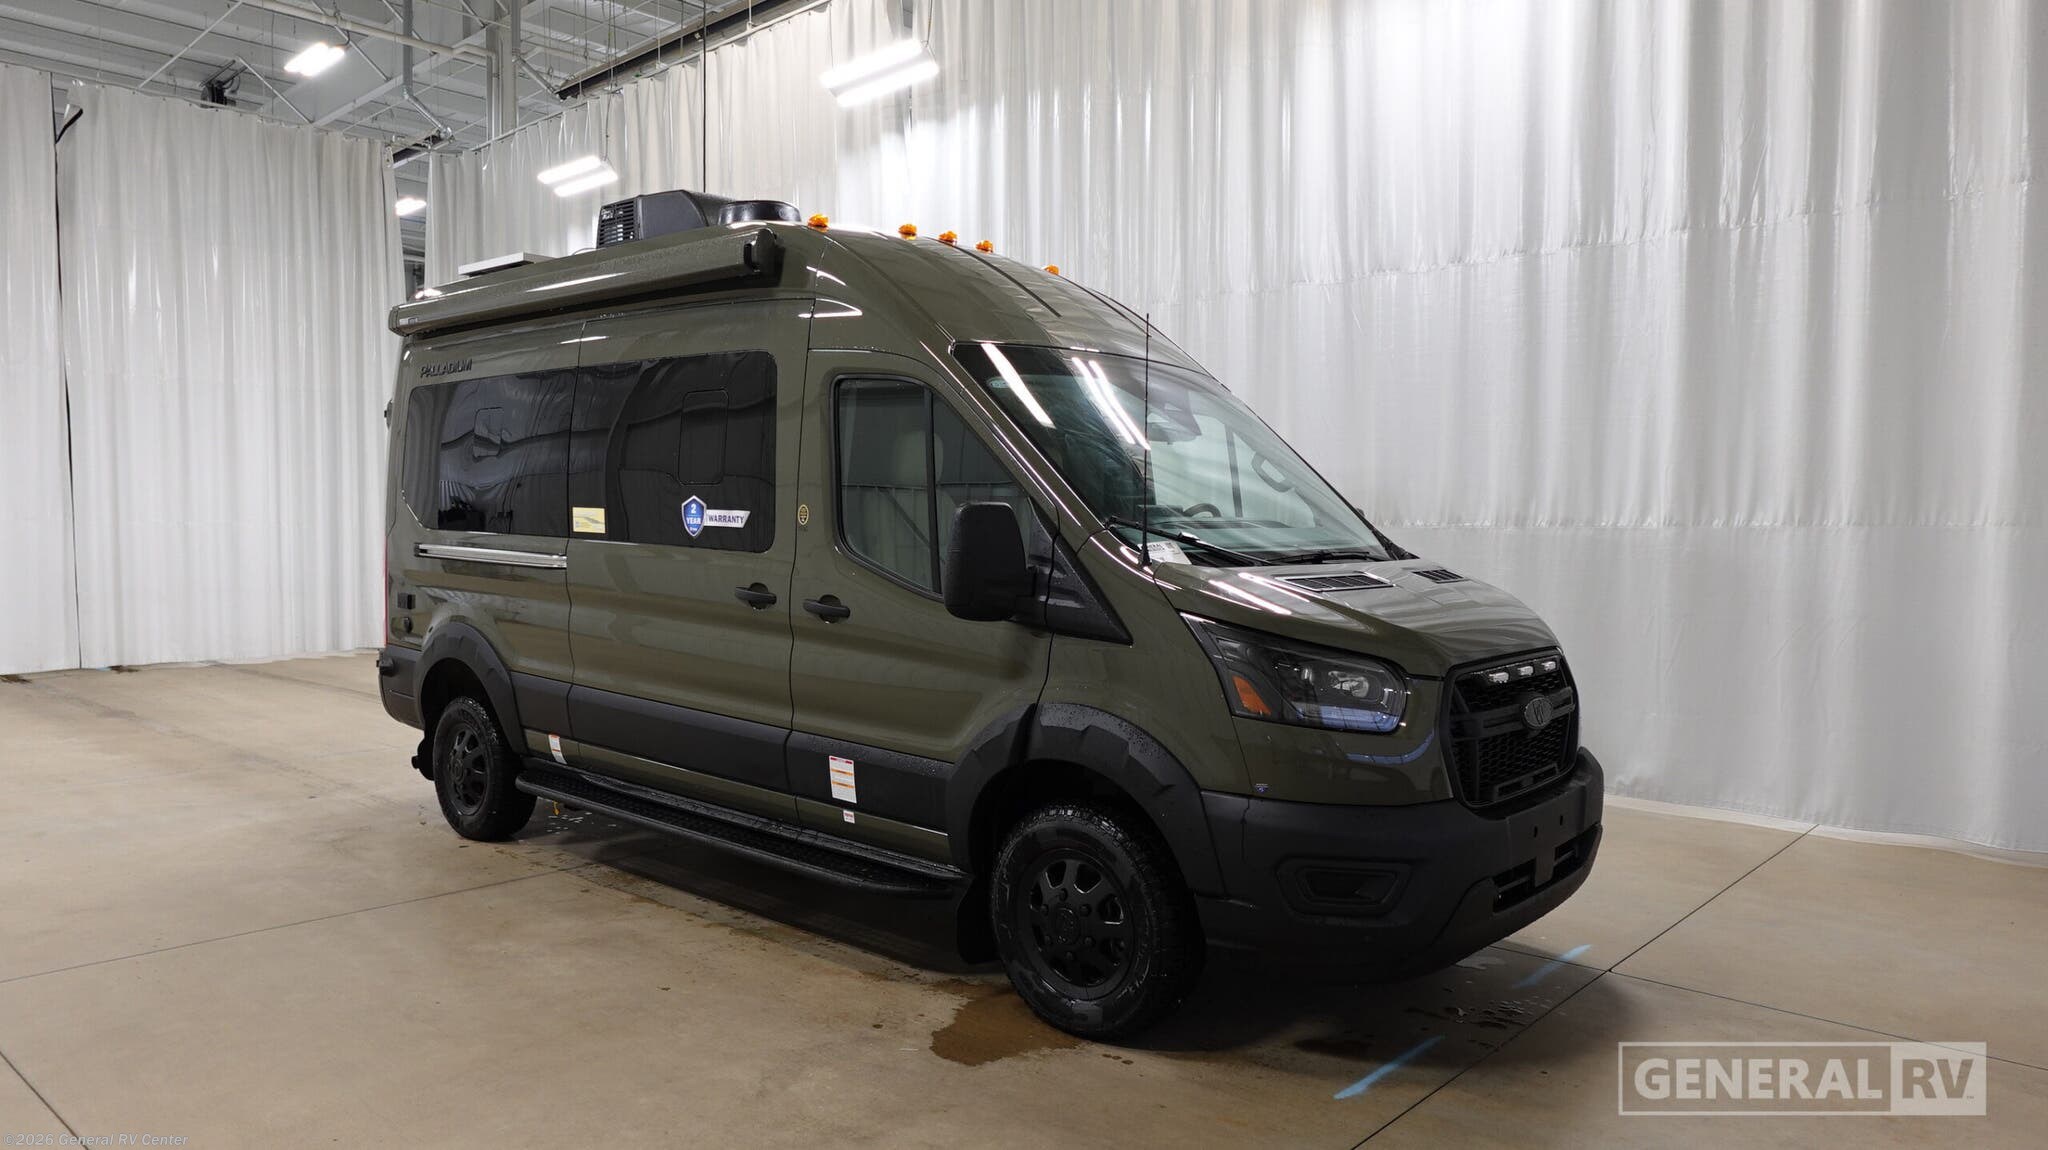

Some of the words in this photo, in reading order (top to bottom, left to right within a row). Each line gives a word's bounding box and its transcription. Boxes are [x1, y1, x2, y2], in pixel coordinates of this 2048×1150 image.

[420, 359, 473, 378] PALLADIUM
[690, 503, 697, 514] 2
[686, 516, 701, 525] YEAR
[708, 514, 744, 524] WARRANTY
